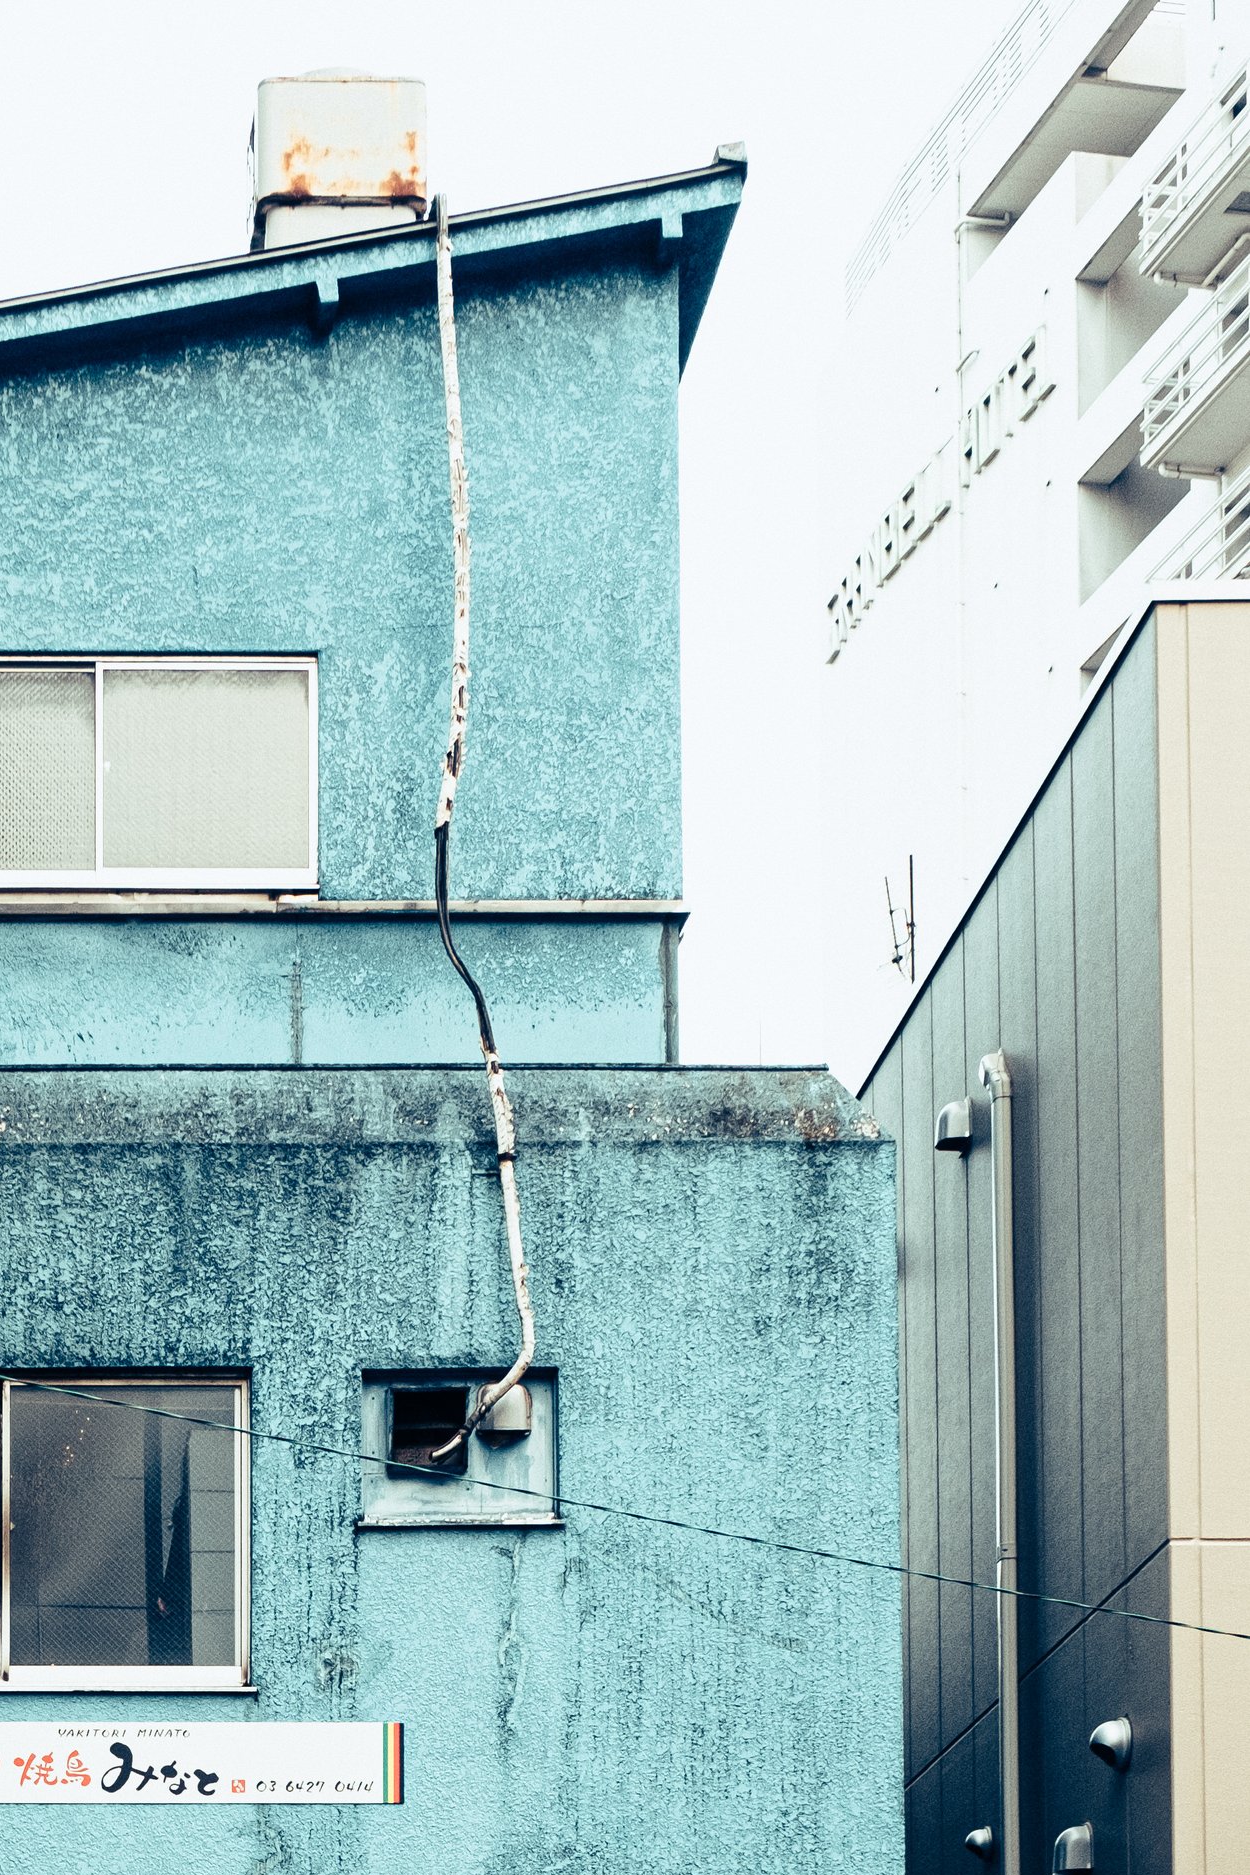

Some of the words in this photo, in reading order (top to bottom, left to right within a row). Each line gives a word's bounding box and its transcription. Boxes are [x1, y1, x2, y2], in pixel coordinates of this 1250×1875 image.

[57, 1727, 127, 1739] YAKITORI
[137, 1728, 192, 1739] MINATO
[12, 1749, 92, 1788] 焼鳥
[100, 1741, 221, 1796] みなと
[256, 1780, 277, 1793] 03
[286, 1780, 326, 1793] 6427
[334, 1780, 375, 1793] 0414
